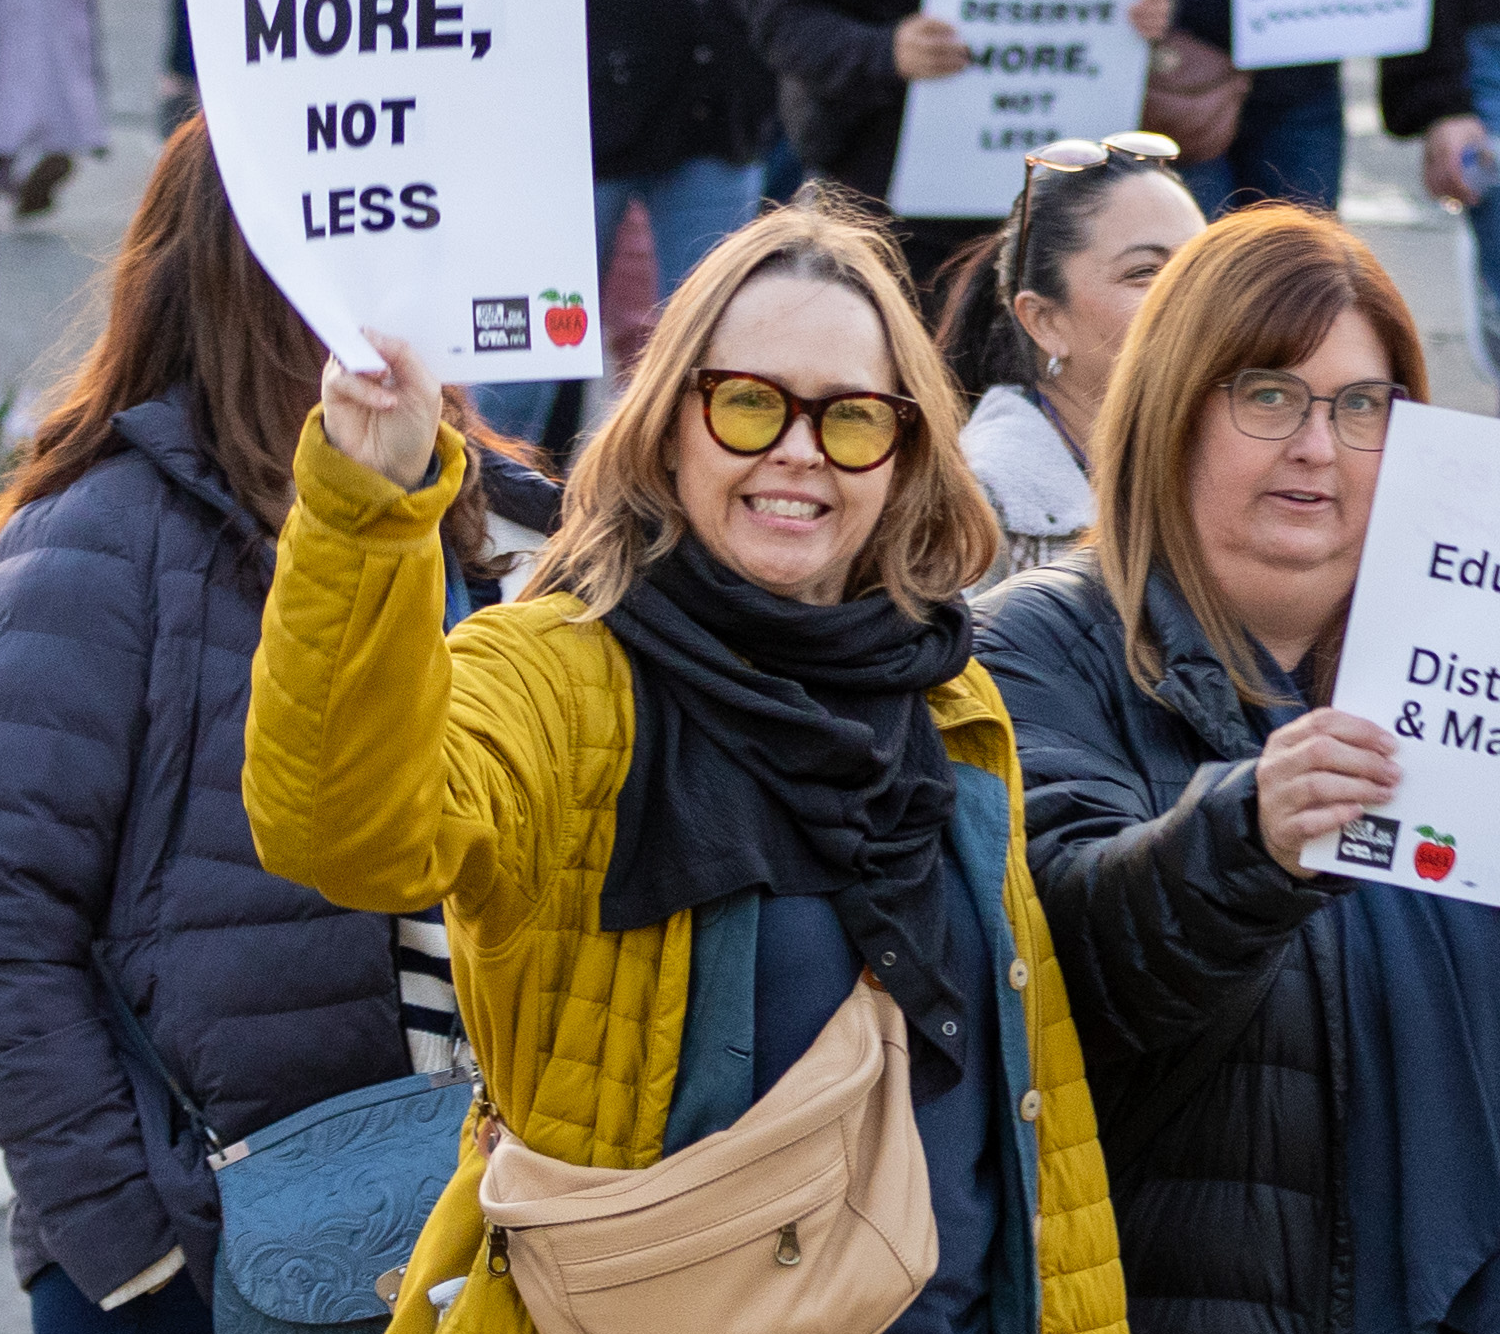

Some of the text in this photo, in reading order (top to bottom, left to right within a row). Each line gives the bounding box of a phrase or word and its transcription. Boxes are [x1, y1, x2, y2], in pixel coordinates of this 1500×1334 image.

[306, 97, 416, 152] NOT
[301, 183, 441, 239] LESS
[1395, 700, 1425, 740] &
